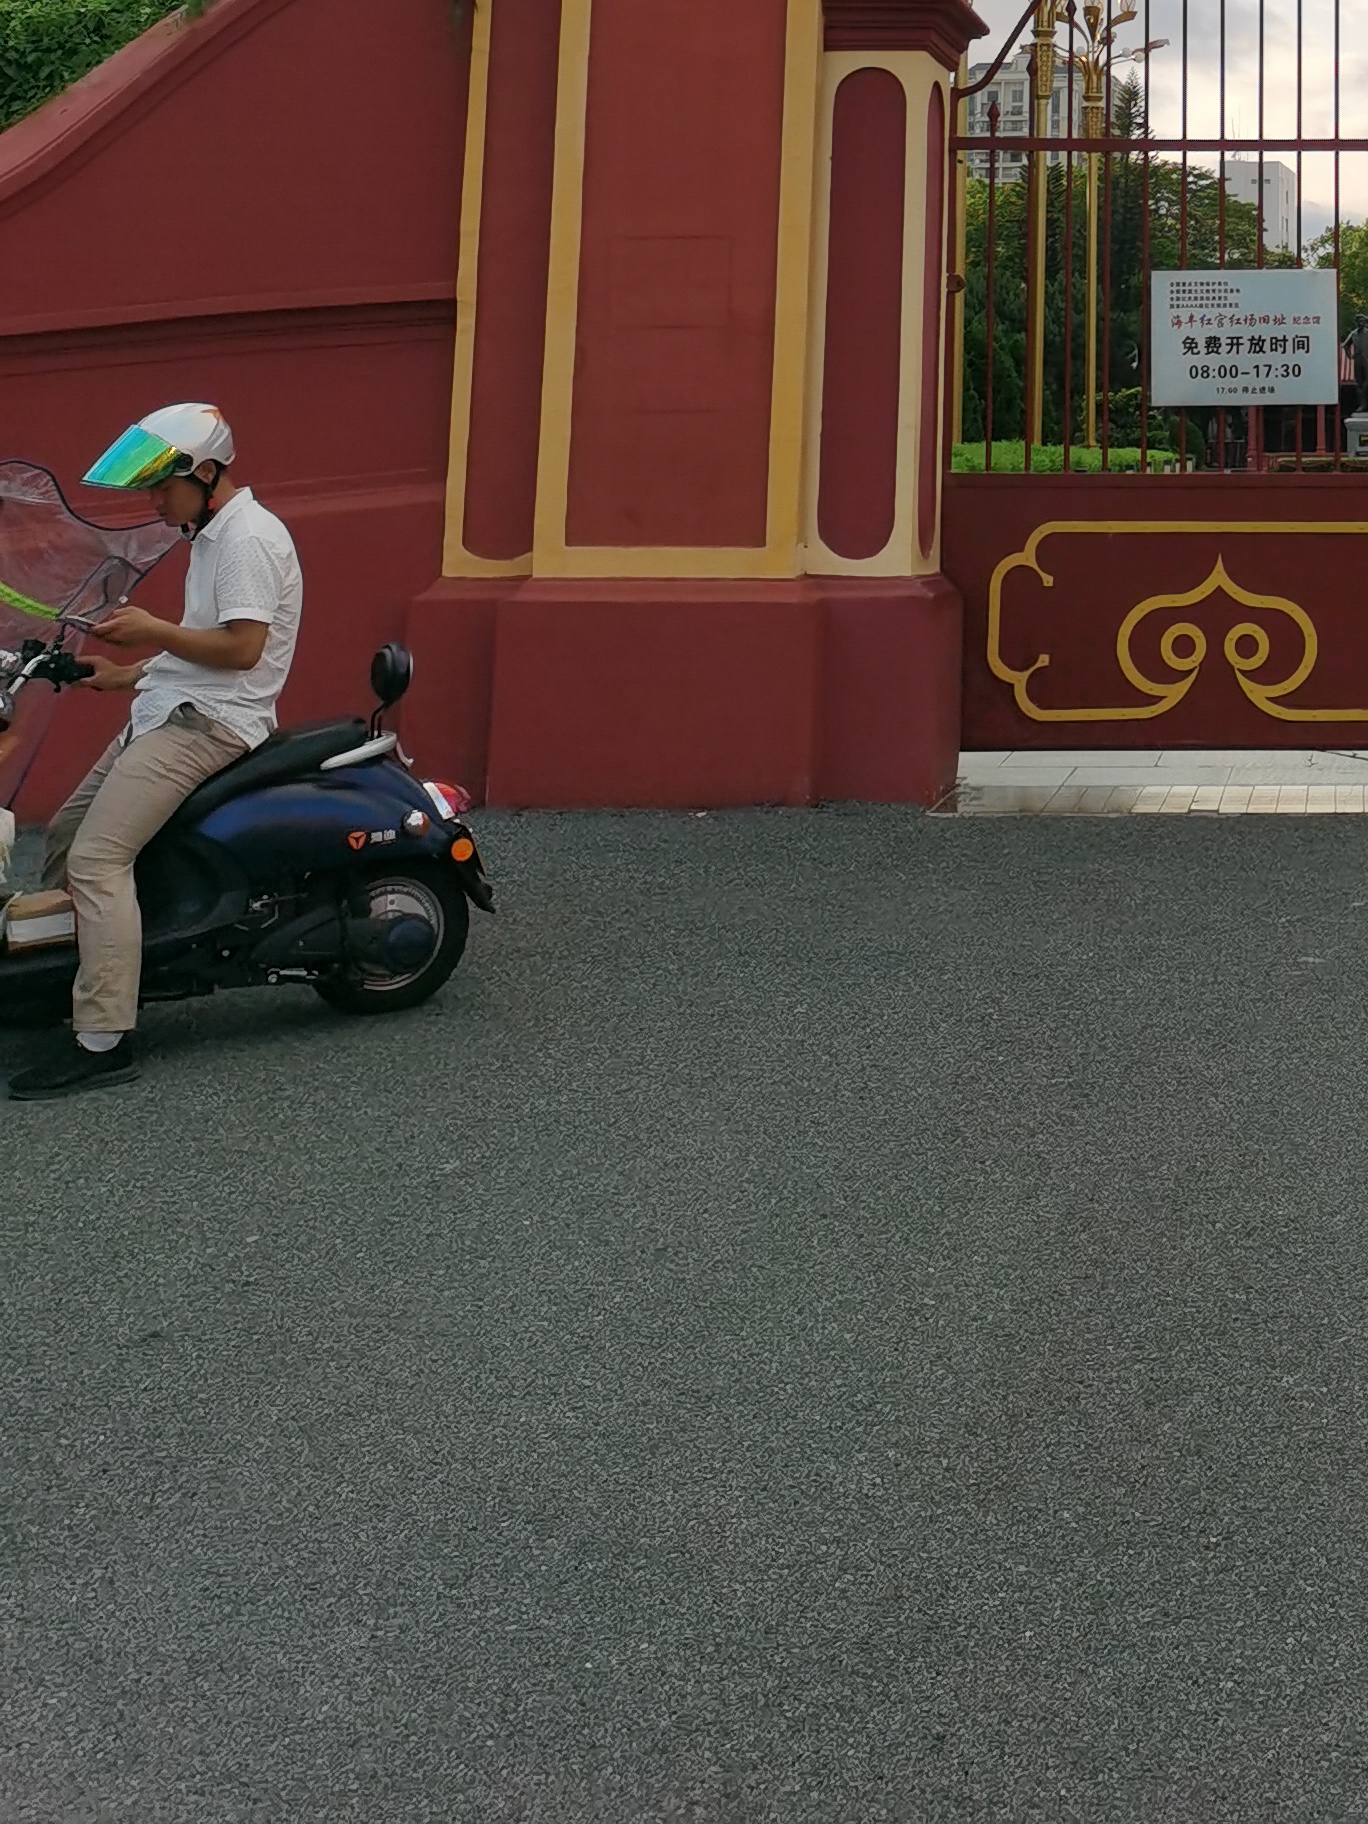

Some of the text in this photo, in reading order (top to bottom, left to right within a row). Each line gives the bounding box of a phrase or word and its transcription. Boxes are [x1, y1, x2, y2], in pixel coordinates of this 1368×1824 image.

[1181, 334, 1310, 356] 免费开放时间
[1188, 363, 1303, 379] 08:00-17:30
